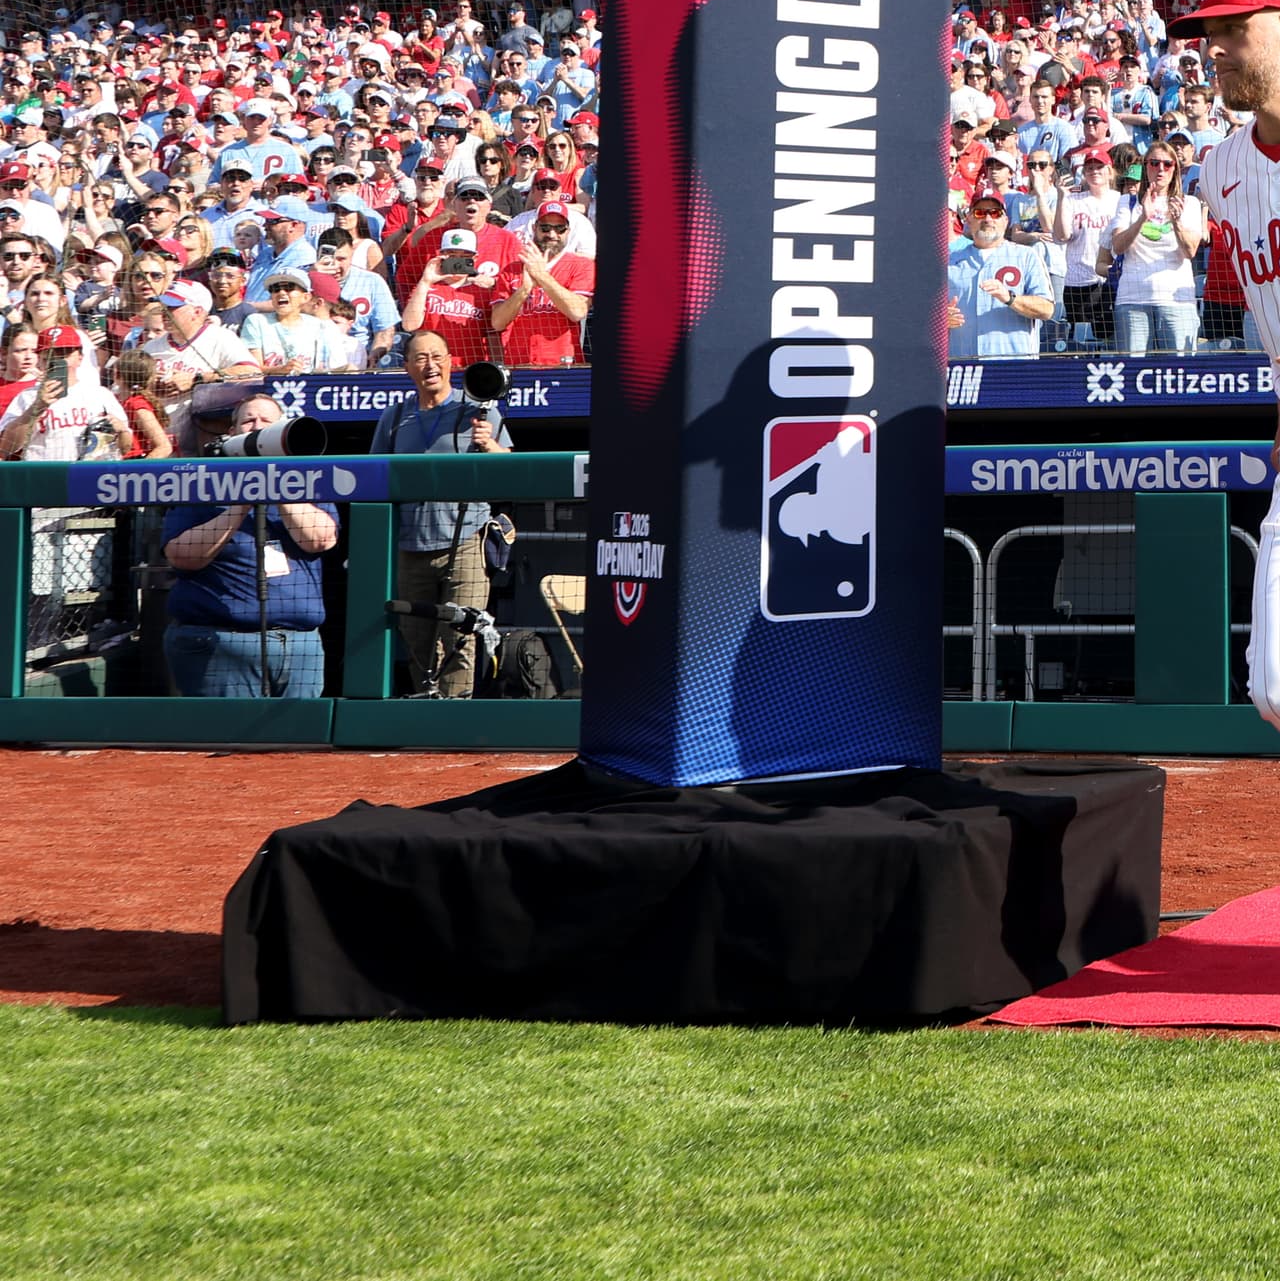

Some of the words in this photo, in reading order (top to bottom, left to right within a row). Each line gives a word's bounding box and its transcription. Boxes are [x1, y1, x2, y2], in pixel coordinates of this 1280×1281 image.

[263, 154, 284, 175] P
[768, 34, 880, 400] OPENING
[505, 378, 552, 407] ark
[1135, 366, 1248, 395] Citizens
[96, 462, 323, 504] smartwater
[970, 448, 1228, 492] smartwater
[631, 513, 650, 537] 2026
[596, 539, 642, 578] OPENING
[642, 540, 666, 579] DAY
